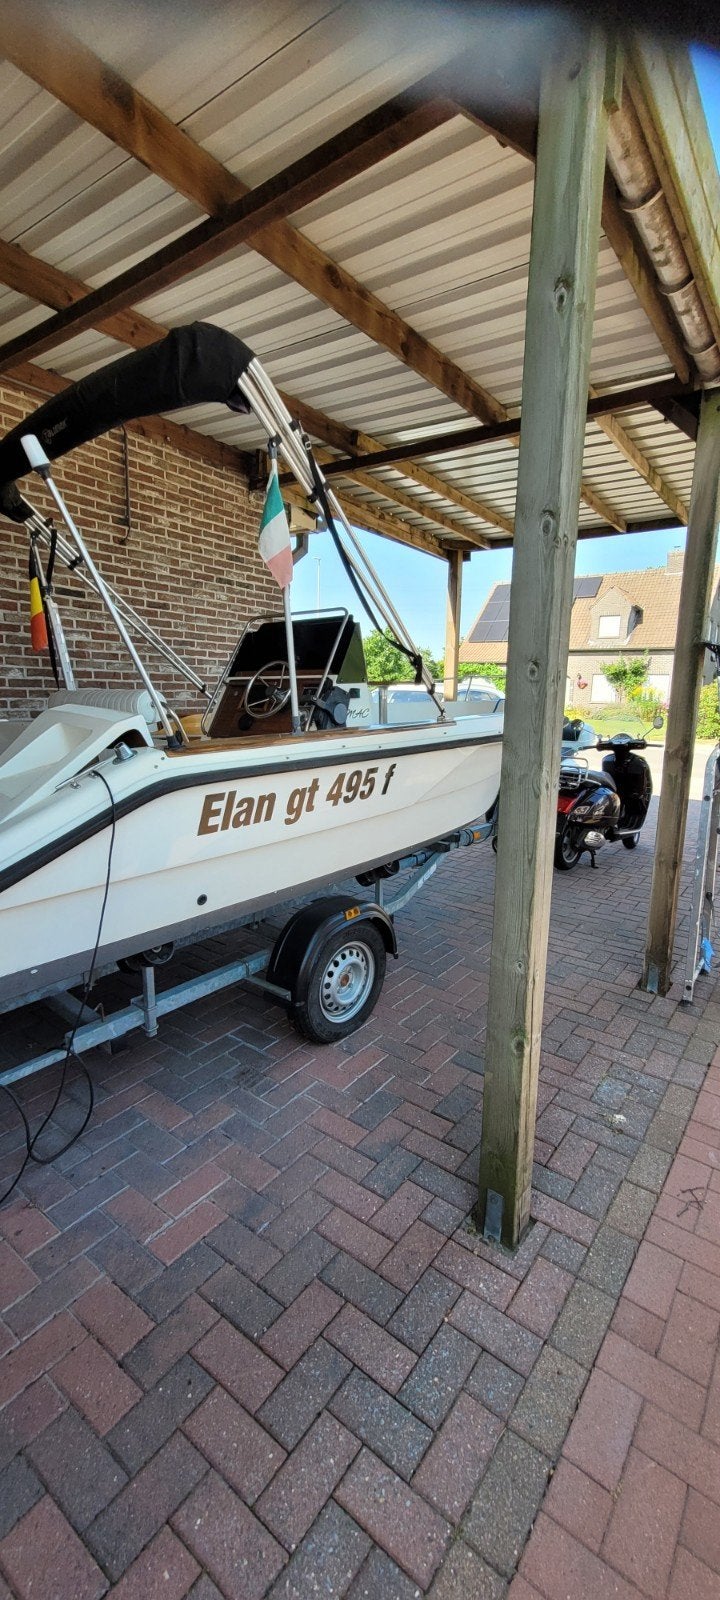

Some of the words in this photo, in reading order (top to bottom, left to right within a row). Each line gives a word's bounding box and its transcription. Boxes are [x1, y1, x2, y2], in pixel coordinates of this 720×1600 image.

[197, 790, 277, 836] Elan
[284, 778, 320, 826] gt
[325, 767, 379, 807] 495
[381, 763, 397, 795] f
